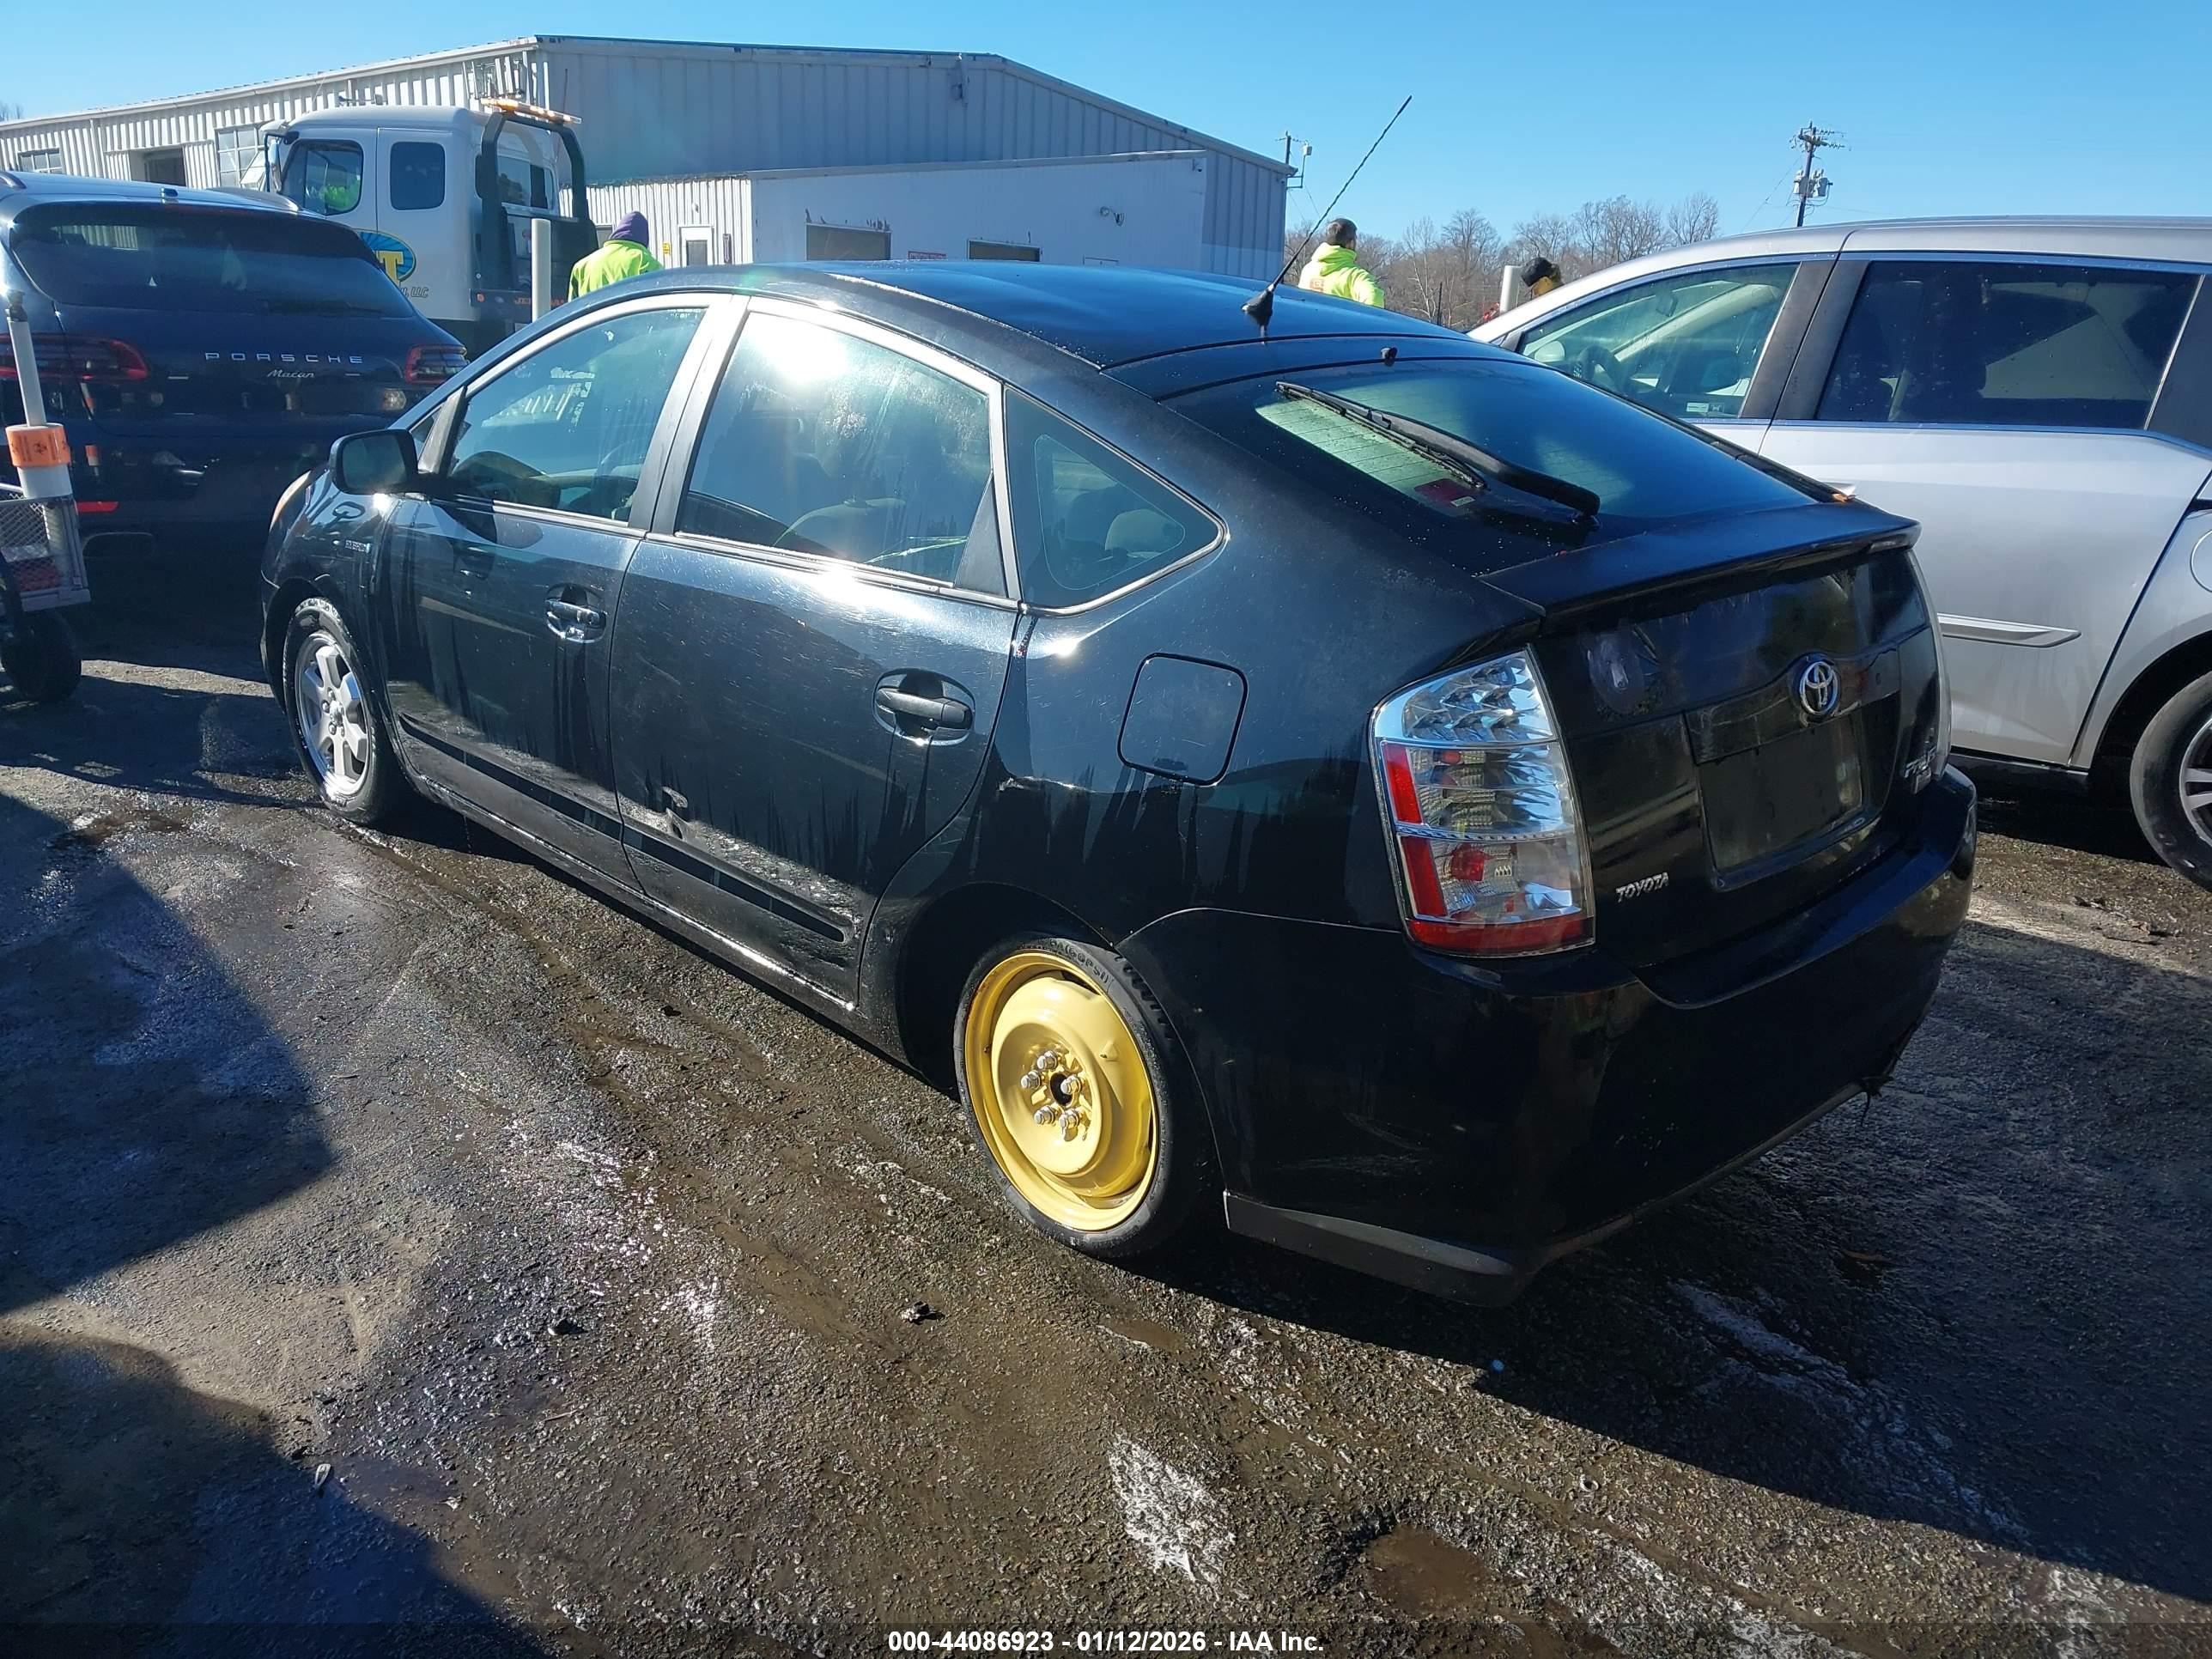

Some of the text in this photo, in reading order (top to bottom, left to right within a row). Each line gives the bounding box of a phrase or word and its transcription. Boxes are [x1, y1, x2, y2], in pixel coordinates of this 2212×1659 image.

[411, 287, 428, 298] LLC
[204, 352, 362, 364] PORSCHE
[267, 369, 314, 379] Macan
[1615, 872, 1668, 902] TOYOTA
